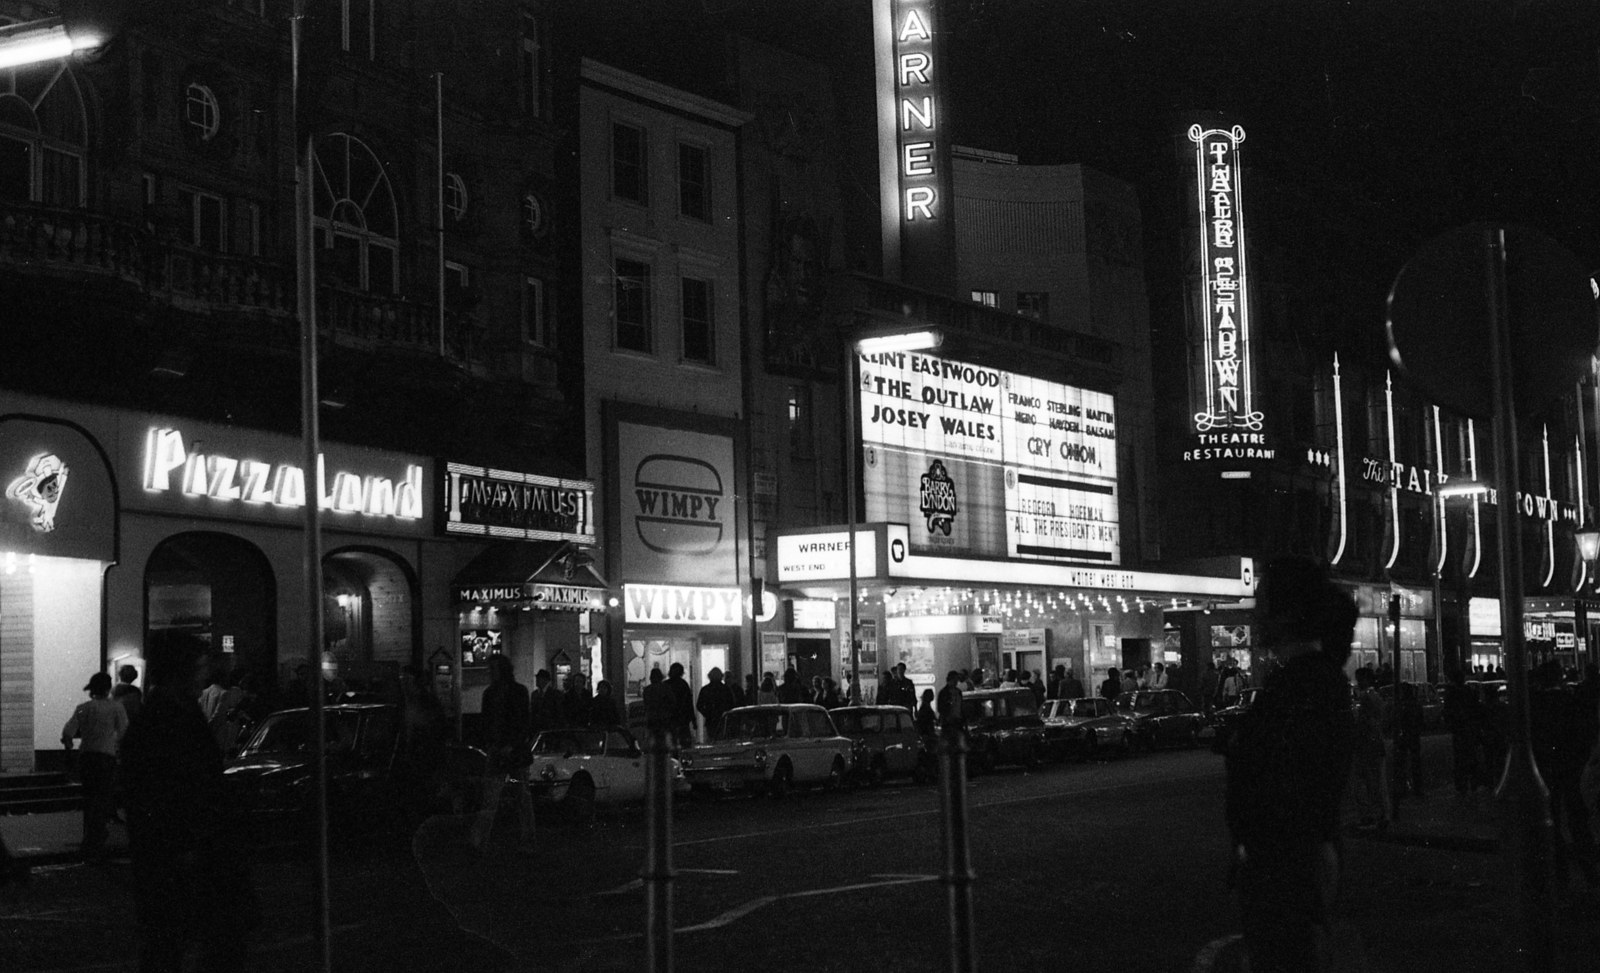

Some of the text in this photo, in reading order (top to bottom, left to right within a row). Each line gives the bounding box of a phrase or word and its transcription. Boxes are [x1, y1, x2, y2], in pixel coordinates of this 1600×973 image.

[911, 355, 1000, 388] EASTWOOD
[874, 375, 994, 414] THE OUTLAW
[1008, 392, 1041, 409] FRANCO
[871, 404, 995, 441] JOSEY WALES
[1027, 436, 1096, 465] CRY ONION
[1198, 433, 1265, 445] THEATRE
[1184, 448, 1275, 461] RESTAURANT
[470, 479, 577, 517] MAXIMUS
[922, 477, 953, 496] BARRY
[635, 489, 720, 521] WIMPY
[921, 489, 956, 512] LYNDON
[783, 563, 826, 572] WEST END
[460, 587, 521, 601] MAXIMUS
[627, 587, 738, 622] WIMPY
